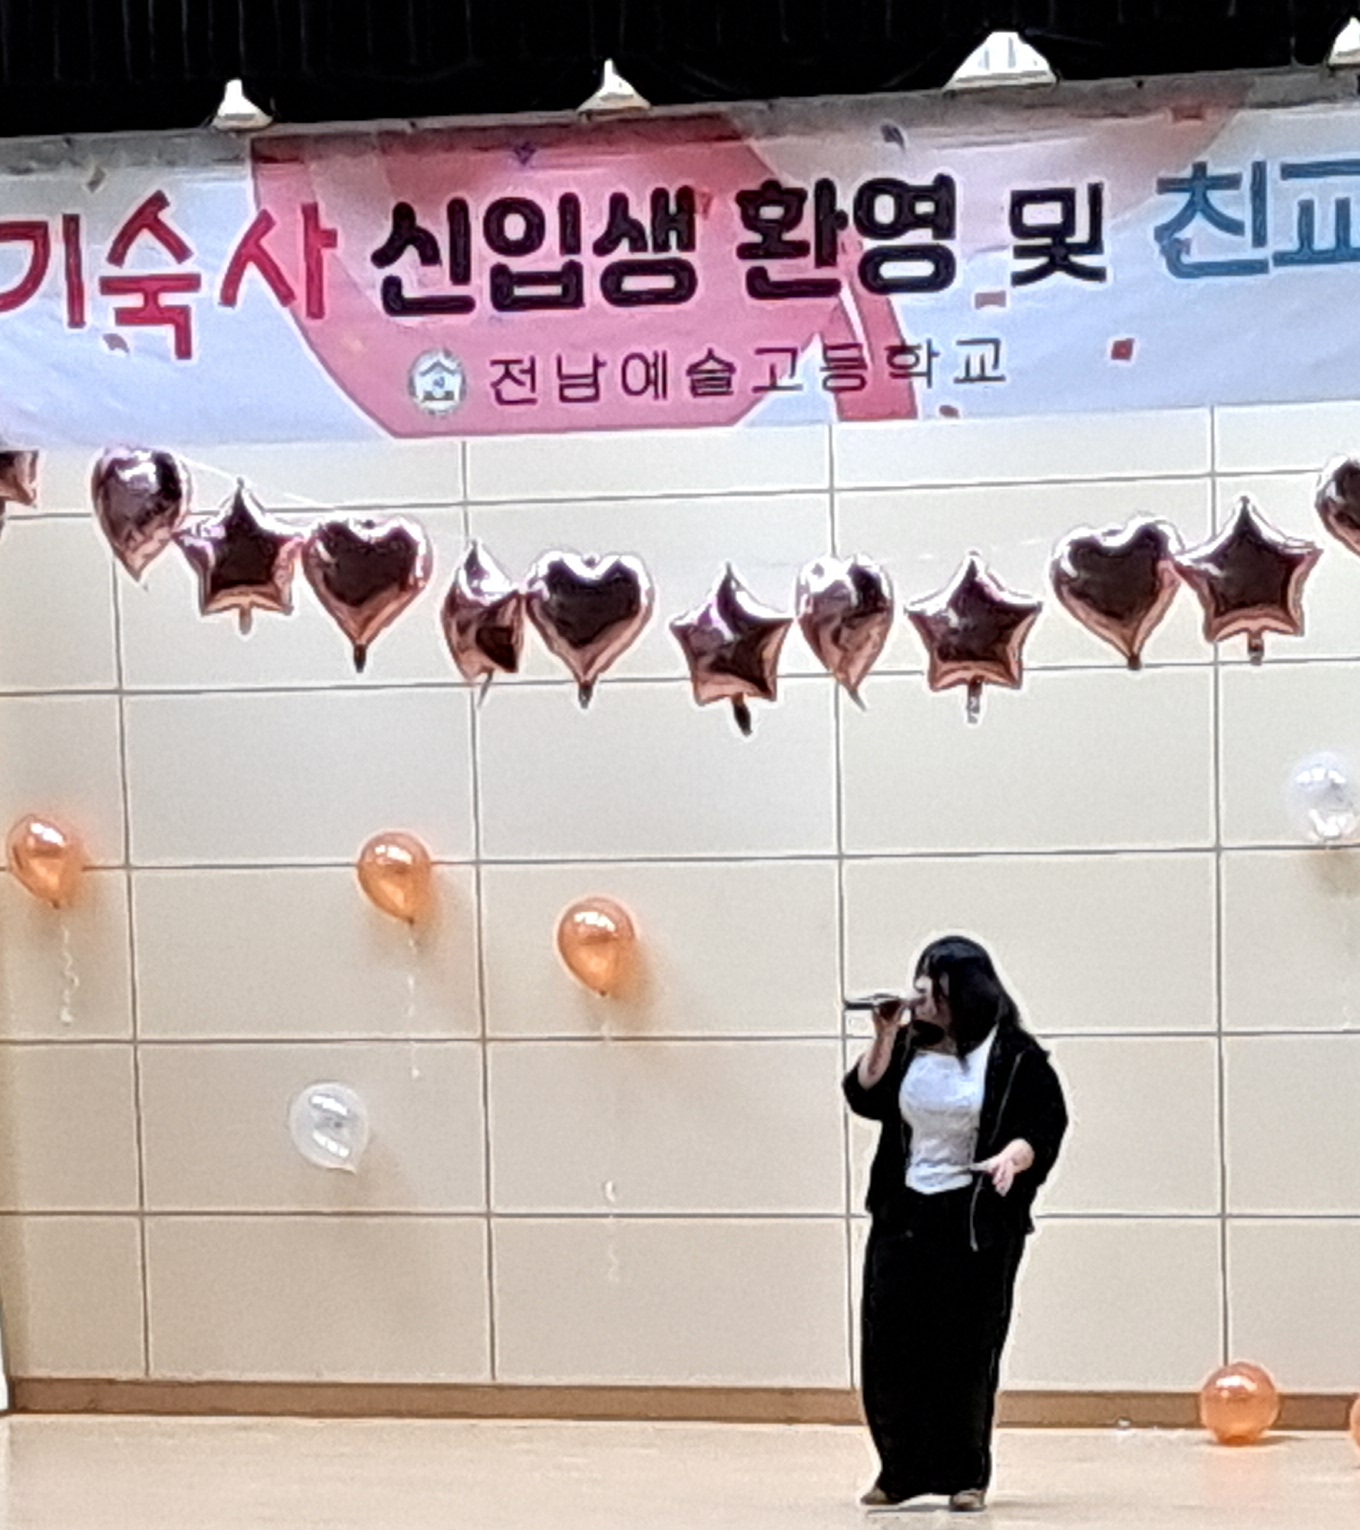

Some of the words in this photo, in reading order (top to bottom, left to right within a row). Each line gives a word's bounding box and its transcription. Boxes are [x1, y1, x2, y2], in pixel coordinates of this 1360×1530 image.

[370, 184, 700, 318] 신입생
[734, 171, 958, 301] 환영
[1007, 181, 1108, 287] 및
[487, 336, 1008, 406] 전남예술고등학교
